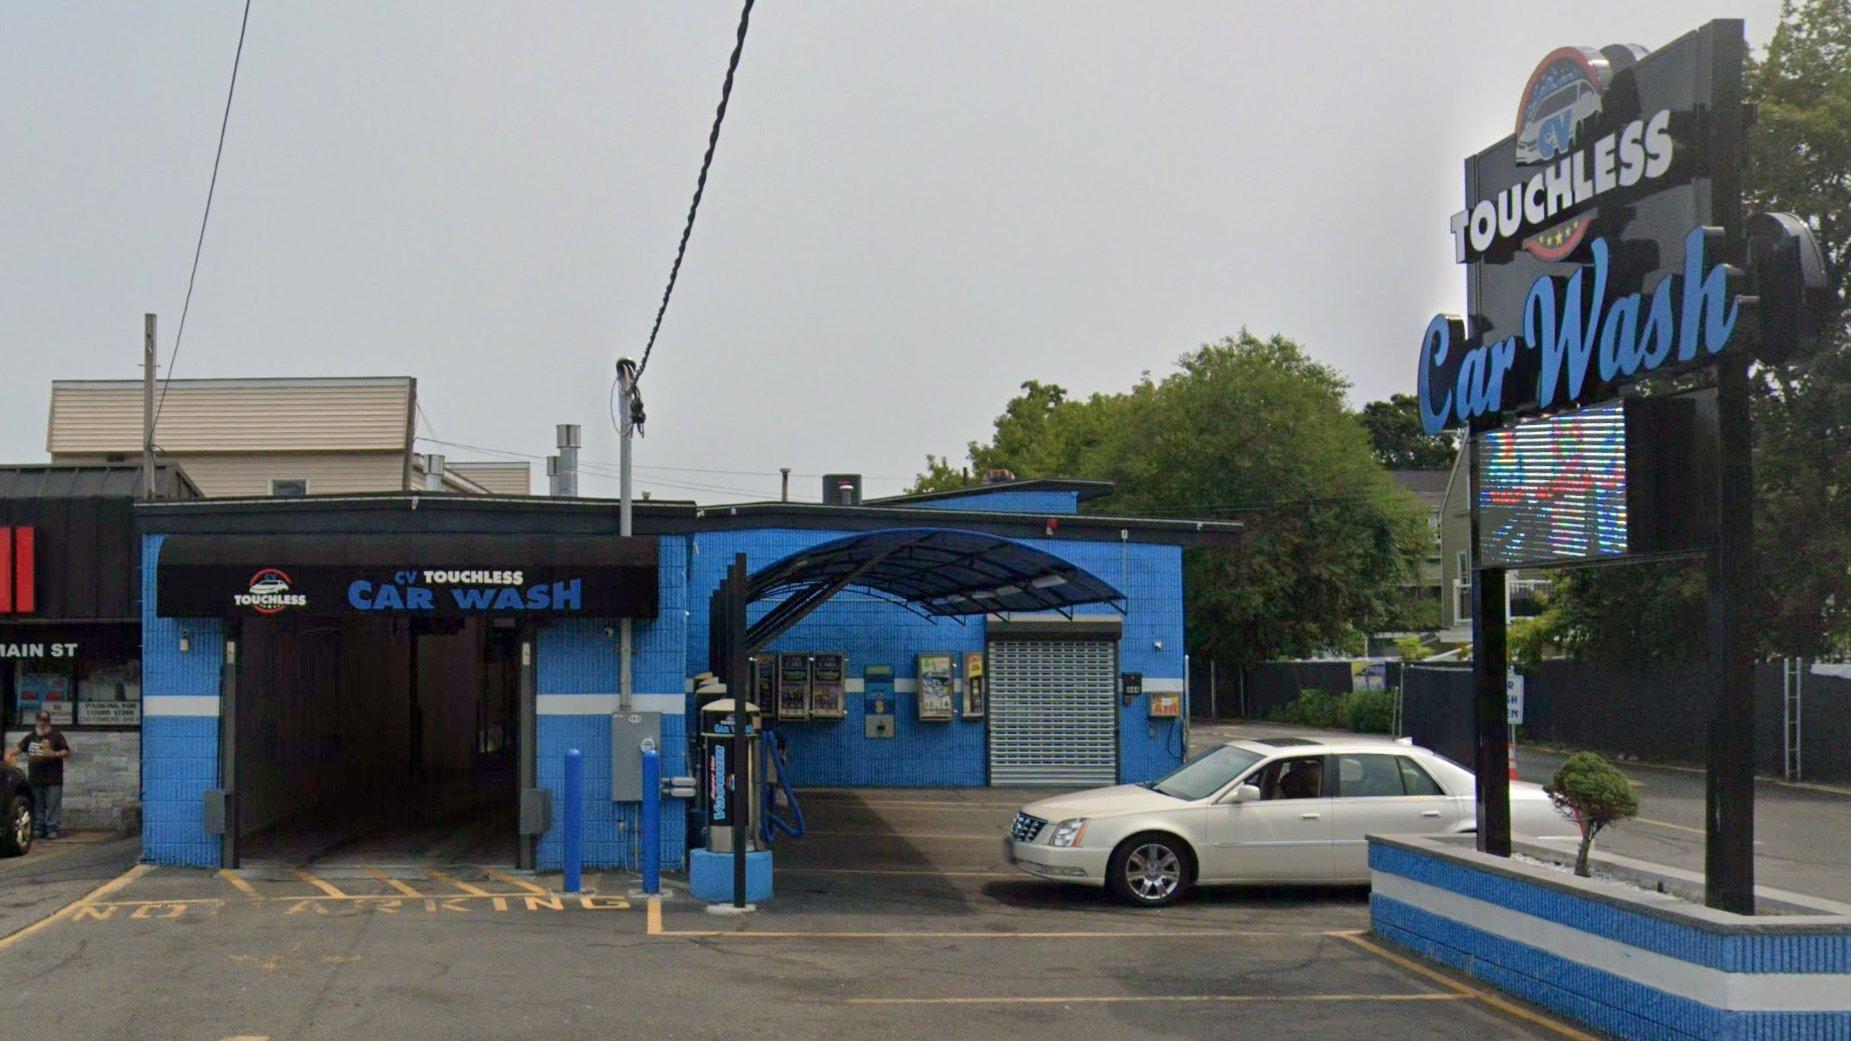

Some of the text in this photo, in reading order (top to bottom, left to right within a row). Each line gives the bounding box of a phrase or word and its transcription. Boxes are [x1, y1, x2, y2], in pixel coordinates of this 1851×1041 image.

[1450, 109, 1674, 264] TOUCHLESS
[1418, 226, 1741, 436] Car Wash
[394, 570, 524, 585] CV TOUCHLESS
[233, 593, 308, 606] TOUCHLESS
[347, 577, 583, 611] CAR WASH
[50, 643, 78, 657] ST
